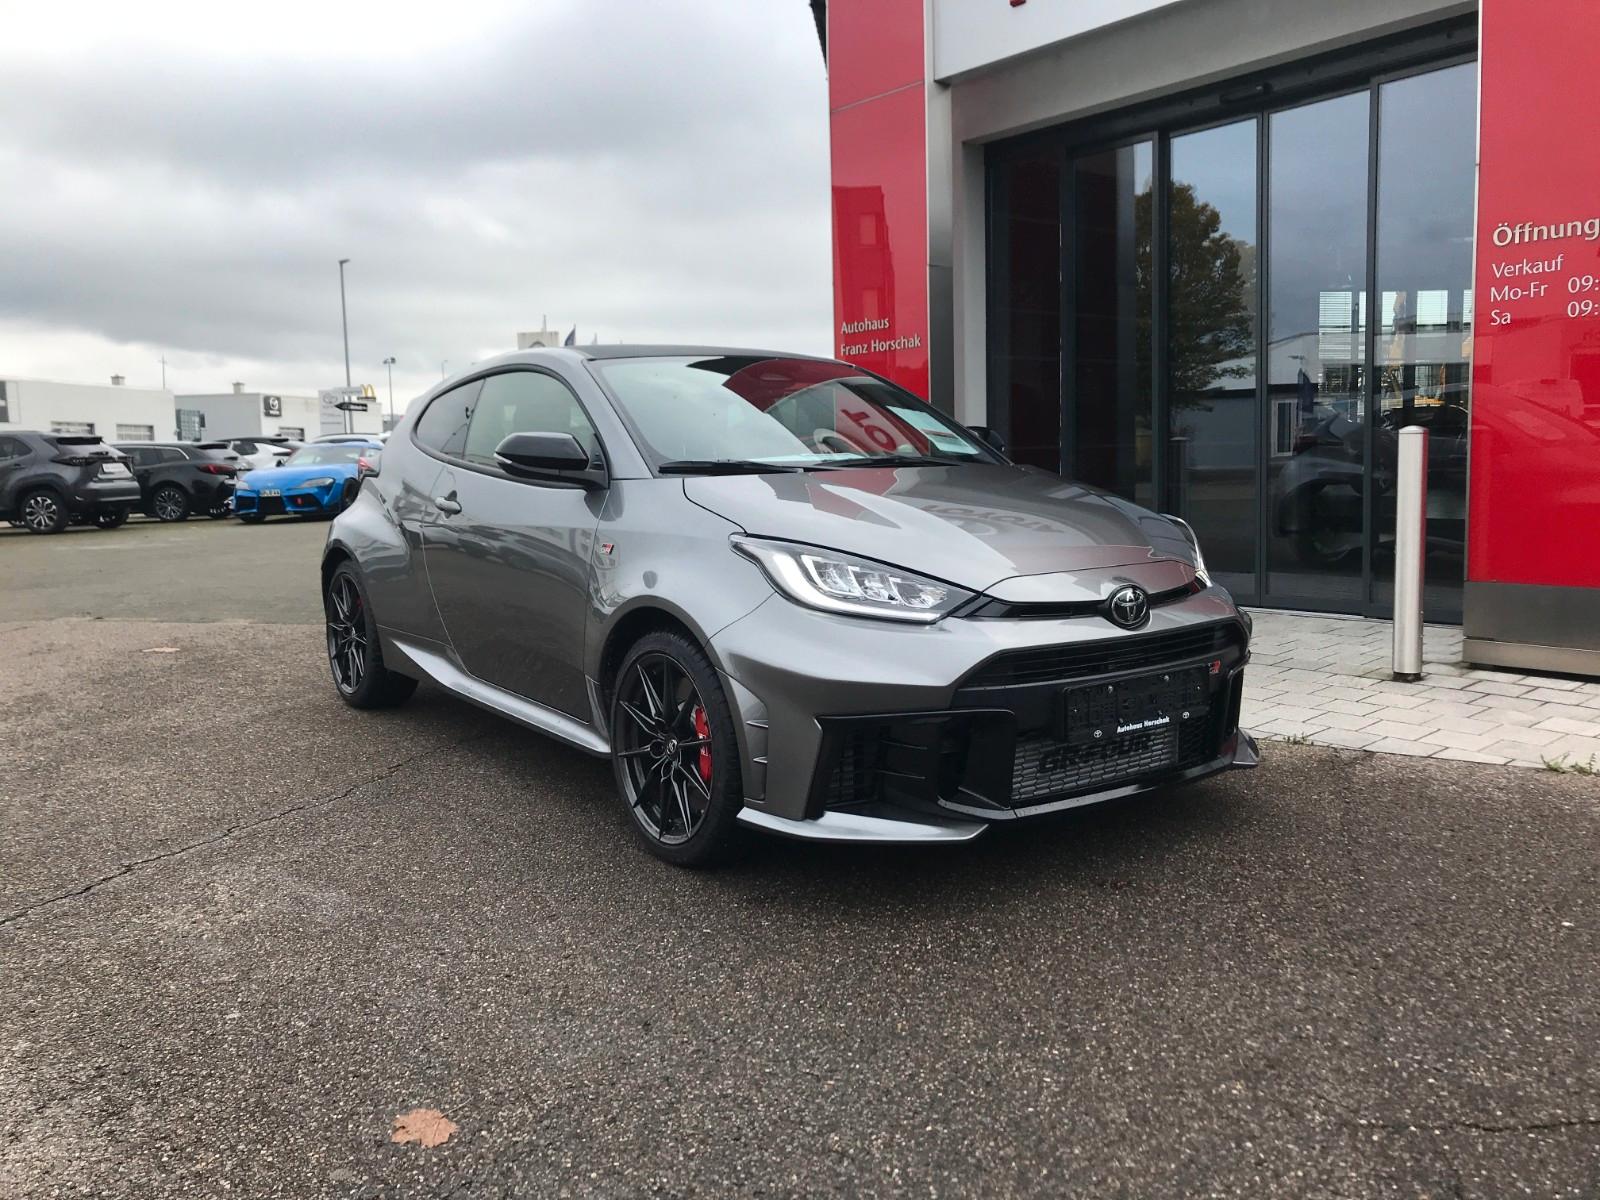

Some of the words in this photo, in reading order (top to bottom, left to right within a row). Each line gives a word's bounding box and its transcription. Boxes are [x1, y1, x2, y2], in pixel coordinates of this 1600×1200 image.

[1493, 218, 1600, 246] Öffnung
[1491, 253, 1565, 279] Verkauf
[1490, 281, 1549, 303] Mo-Fr
[840, 317, 890, 334] Autohaus
[1490, 309, 1512, 326] Sa
[840, 343, 868, 357] Franz
[871, 333, 921, 352] Horschak
[1116, 723, 1143, 734] Autohaus
